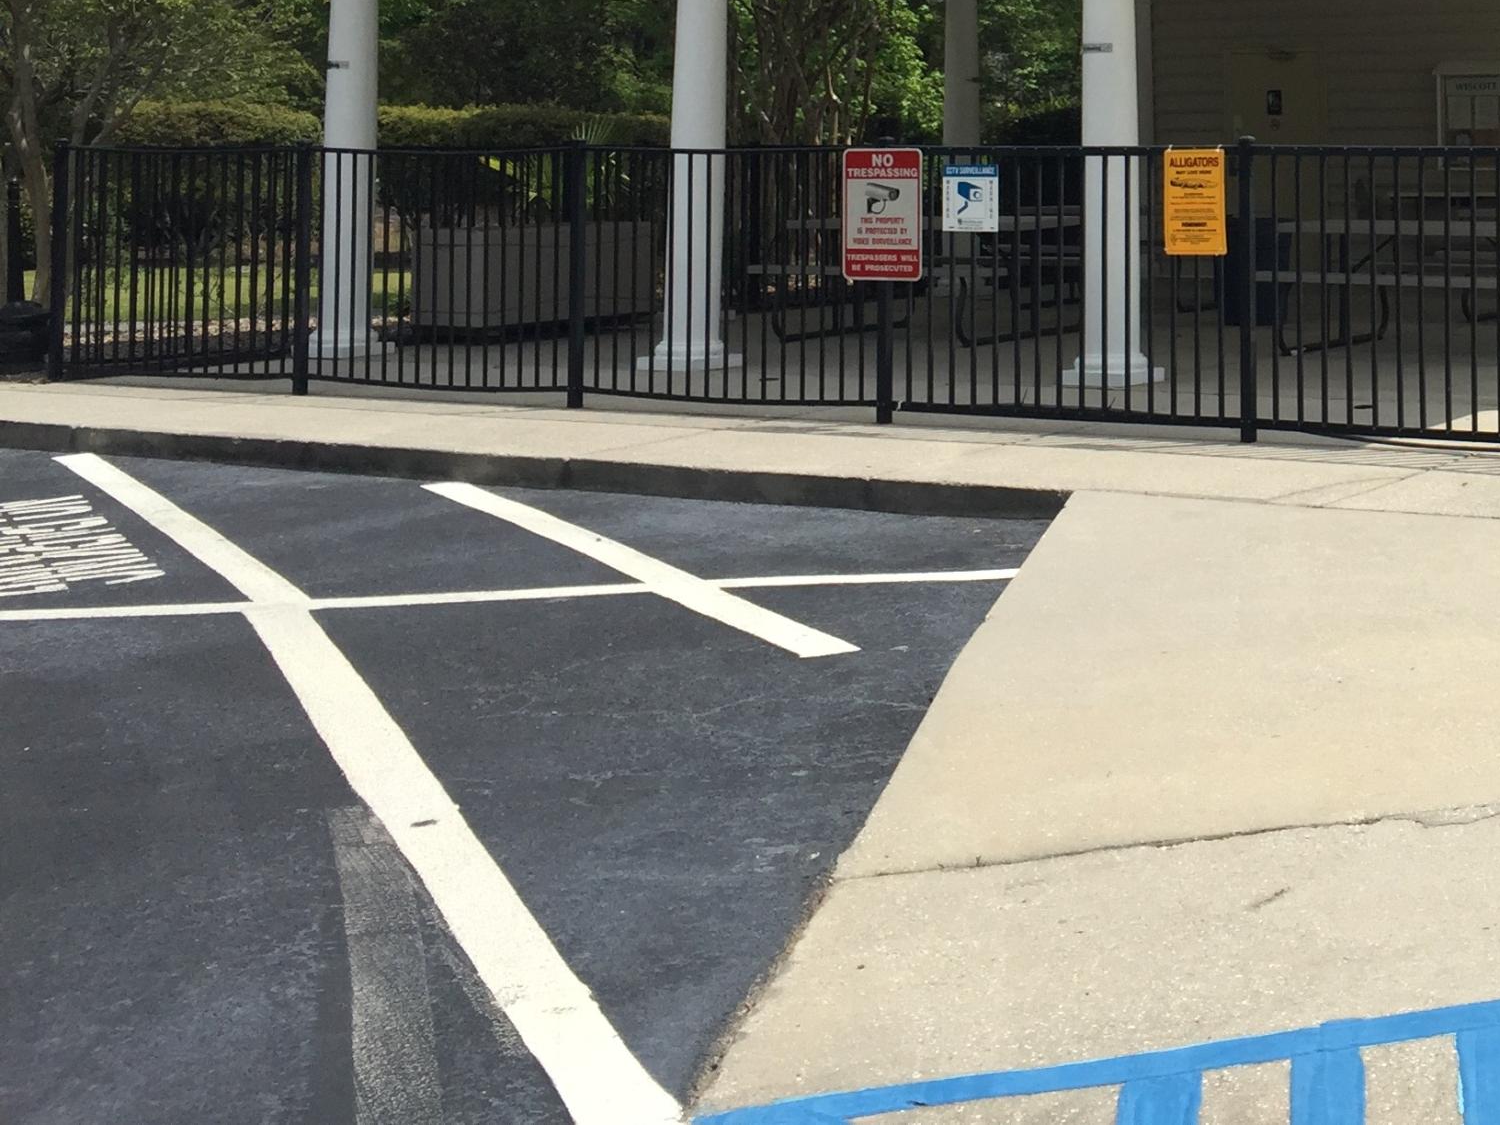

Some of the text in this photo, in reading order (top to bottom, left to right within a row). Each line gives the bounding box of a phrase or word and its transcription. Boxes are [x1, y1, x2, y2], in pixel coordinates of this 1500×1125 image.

[871, 154, 893, 167] NO
[1169, 157, 1219, 168] ALLIGATORS
[847, 168, 918, 178] TRESPASSING
[875, 217, 904, 225] PROPERTY
[872, 238, 912, 246] SURVEILLANCE
[847, 253, 918, 262] TRESPASSERS WILL
[851, 264, 913, 273] BE PROSECUTED
